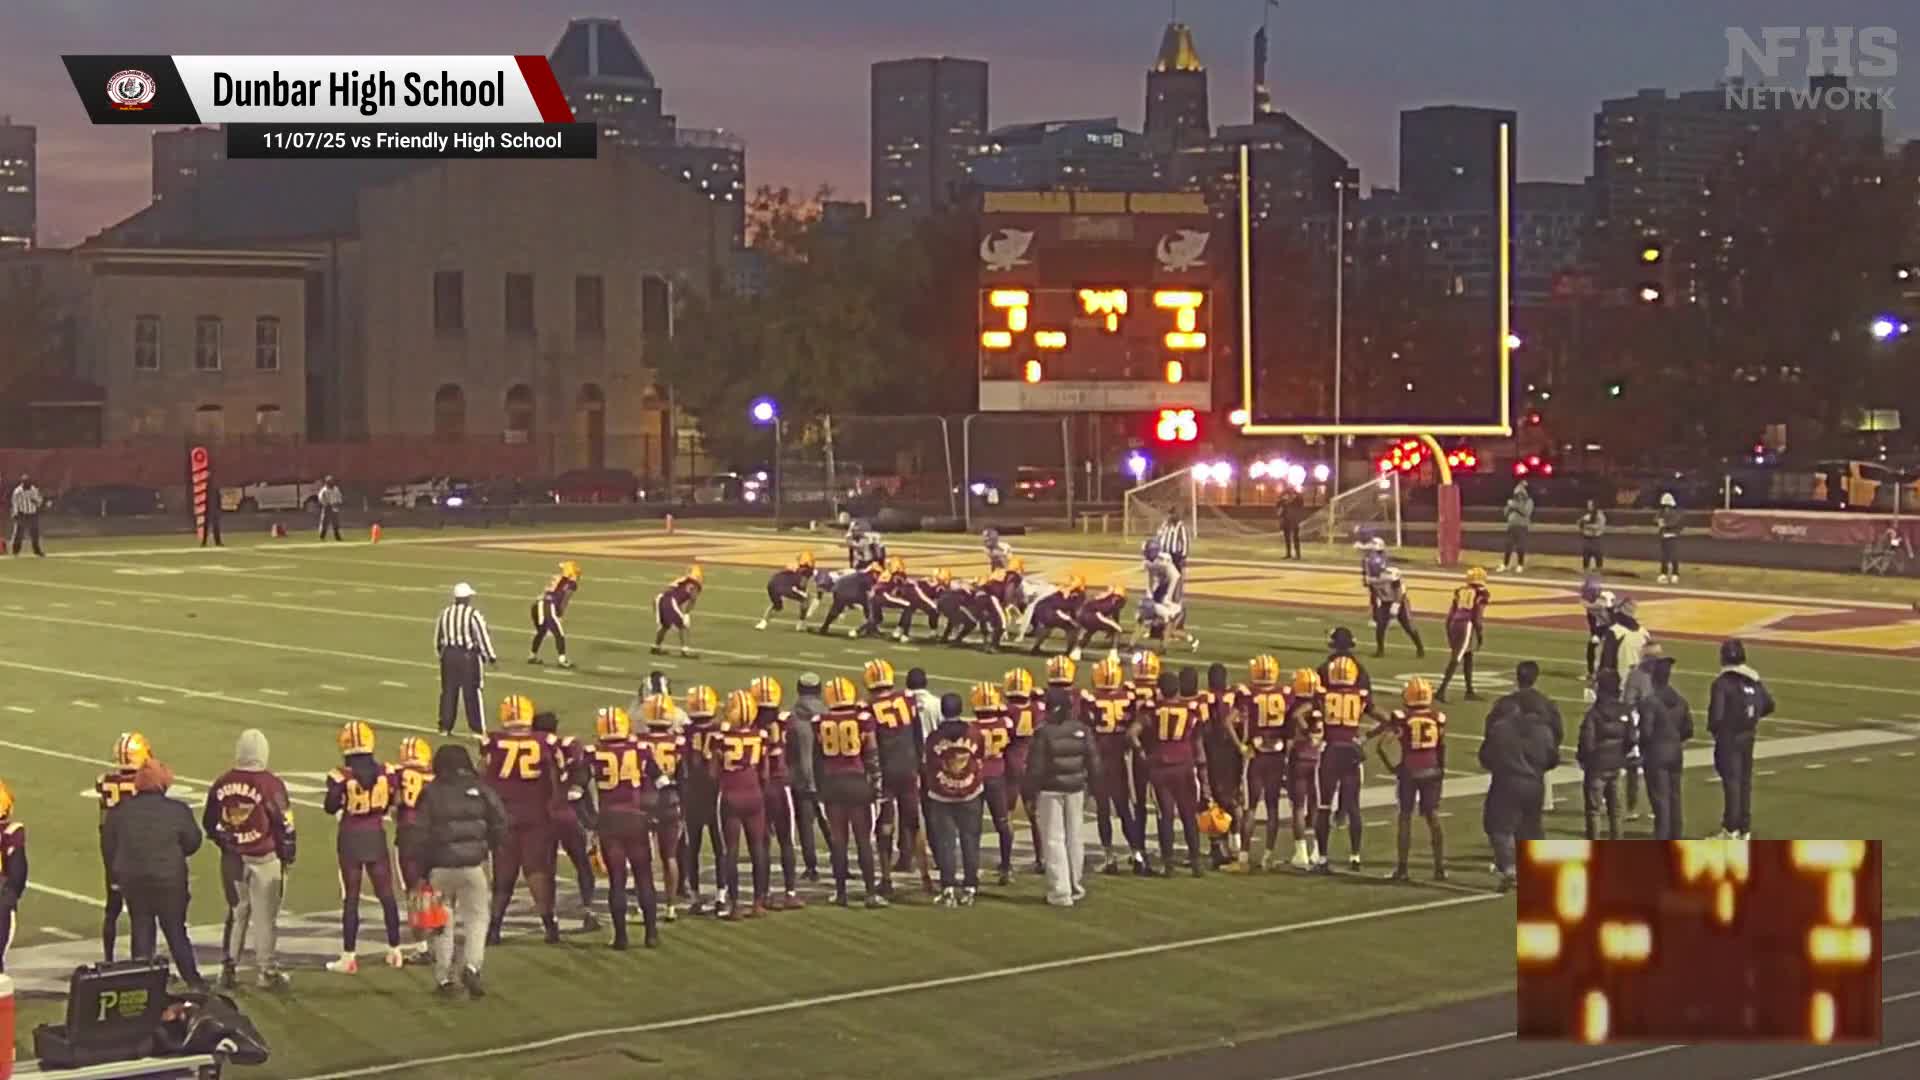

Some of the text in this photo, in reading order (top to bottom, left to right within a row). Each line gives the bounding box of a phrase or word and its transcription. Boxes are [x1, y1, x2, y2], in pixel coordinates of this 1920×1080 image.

[872, 696, 912, 728] 51
[1155, 706, 1188, 741] 17
[1253, 693, 1286, 727] 19
[818, 720, 862, 757] 88
[1407, 716, 1439, 749] 13
[497, 740, 542, 779] 72
[596, 749, 641, 790] 34
[723, 736, 763, 772] 27
[346, 775, 389, 815] 84
